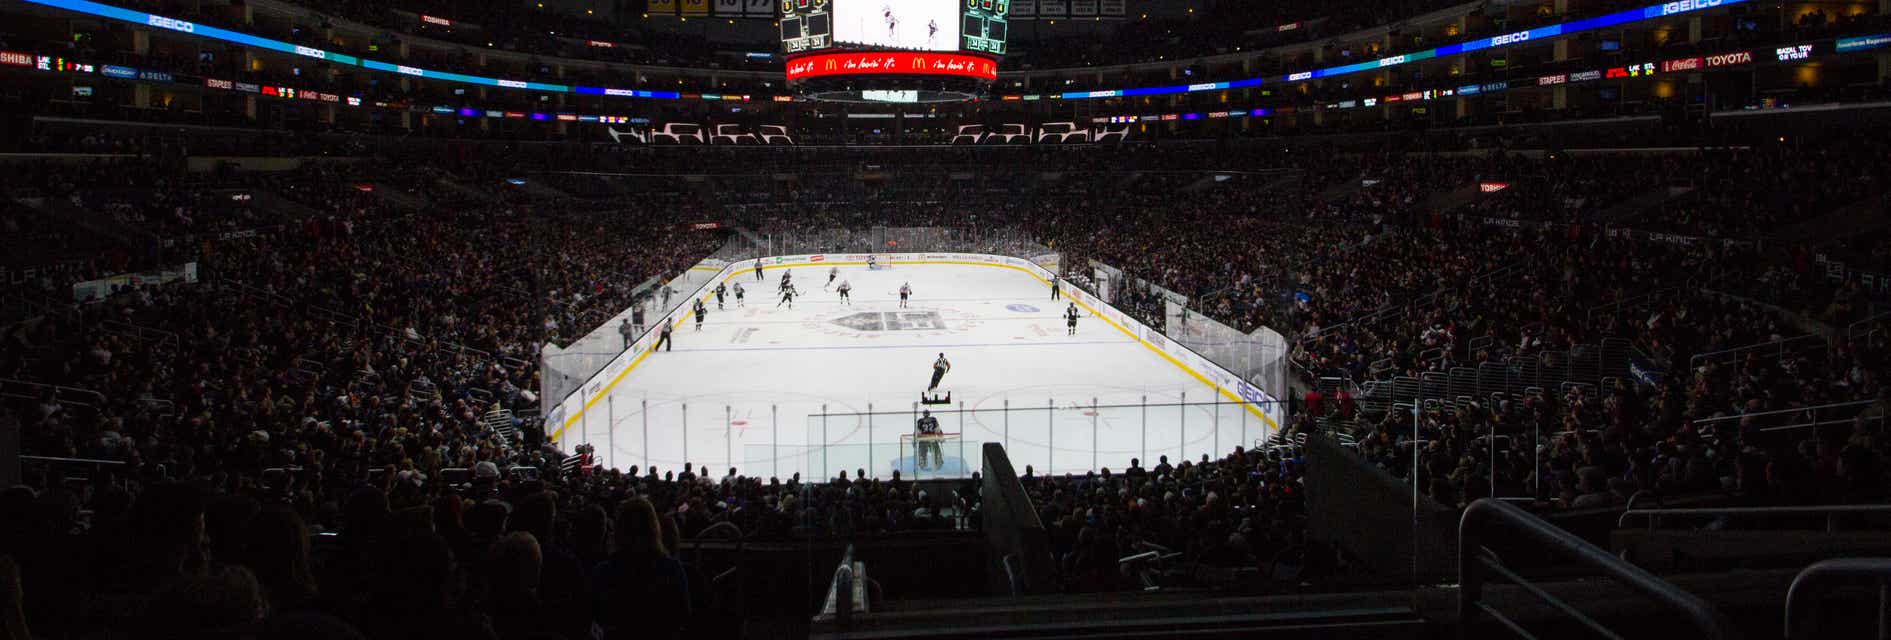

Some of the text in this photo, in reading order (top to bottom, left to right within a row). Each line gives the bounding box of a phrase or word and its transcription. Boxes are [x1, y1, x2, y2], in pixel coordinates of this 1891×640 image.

[149, 14, 194, 33] GEICO
[423, 15, 451, 26] TOSHIBA
[1492, 31, 1530, 47] GEICO
[296, 45, 325, 59] GEICO
[1790, 51, 1808, 60] YOUR
[858, 58, 881, 71] lovin'
[1380, 55, 1404, 67] GEICO
[1706, 52, 1751, 67] TOYOTA
[146, 70, 172, 80] DELTA
[1289, 70, 1312, 81] GEICO
[1538, 74, 1566, 86] STAPLES
[208, 79, 233, 89] STAPLES
[1487, 81, 1507, 91] DELTA
[319, 92, 340, 102] TOYOTA
[1237, 380, 1272, 414] GEICO
